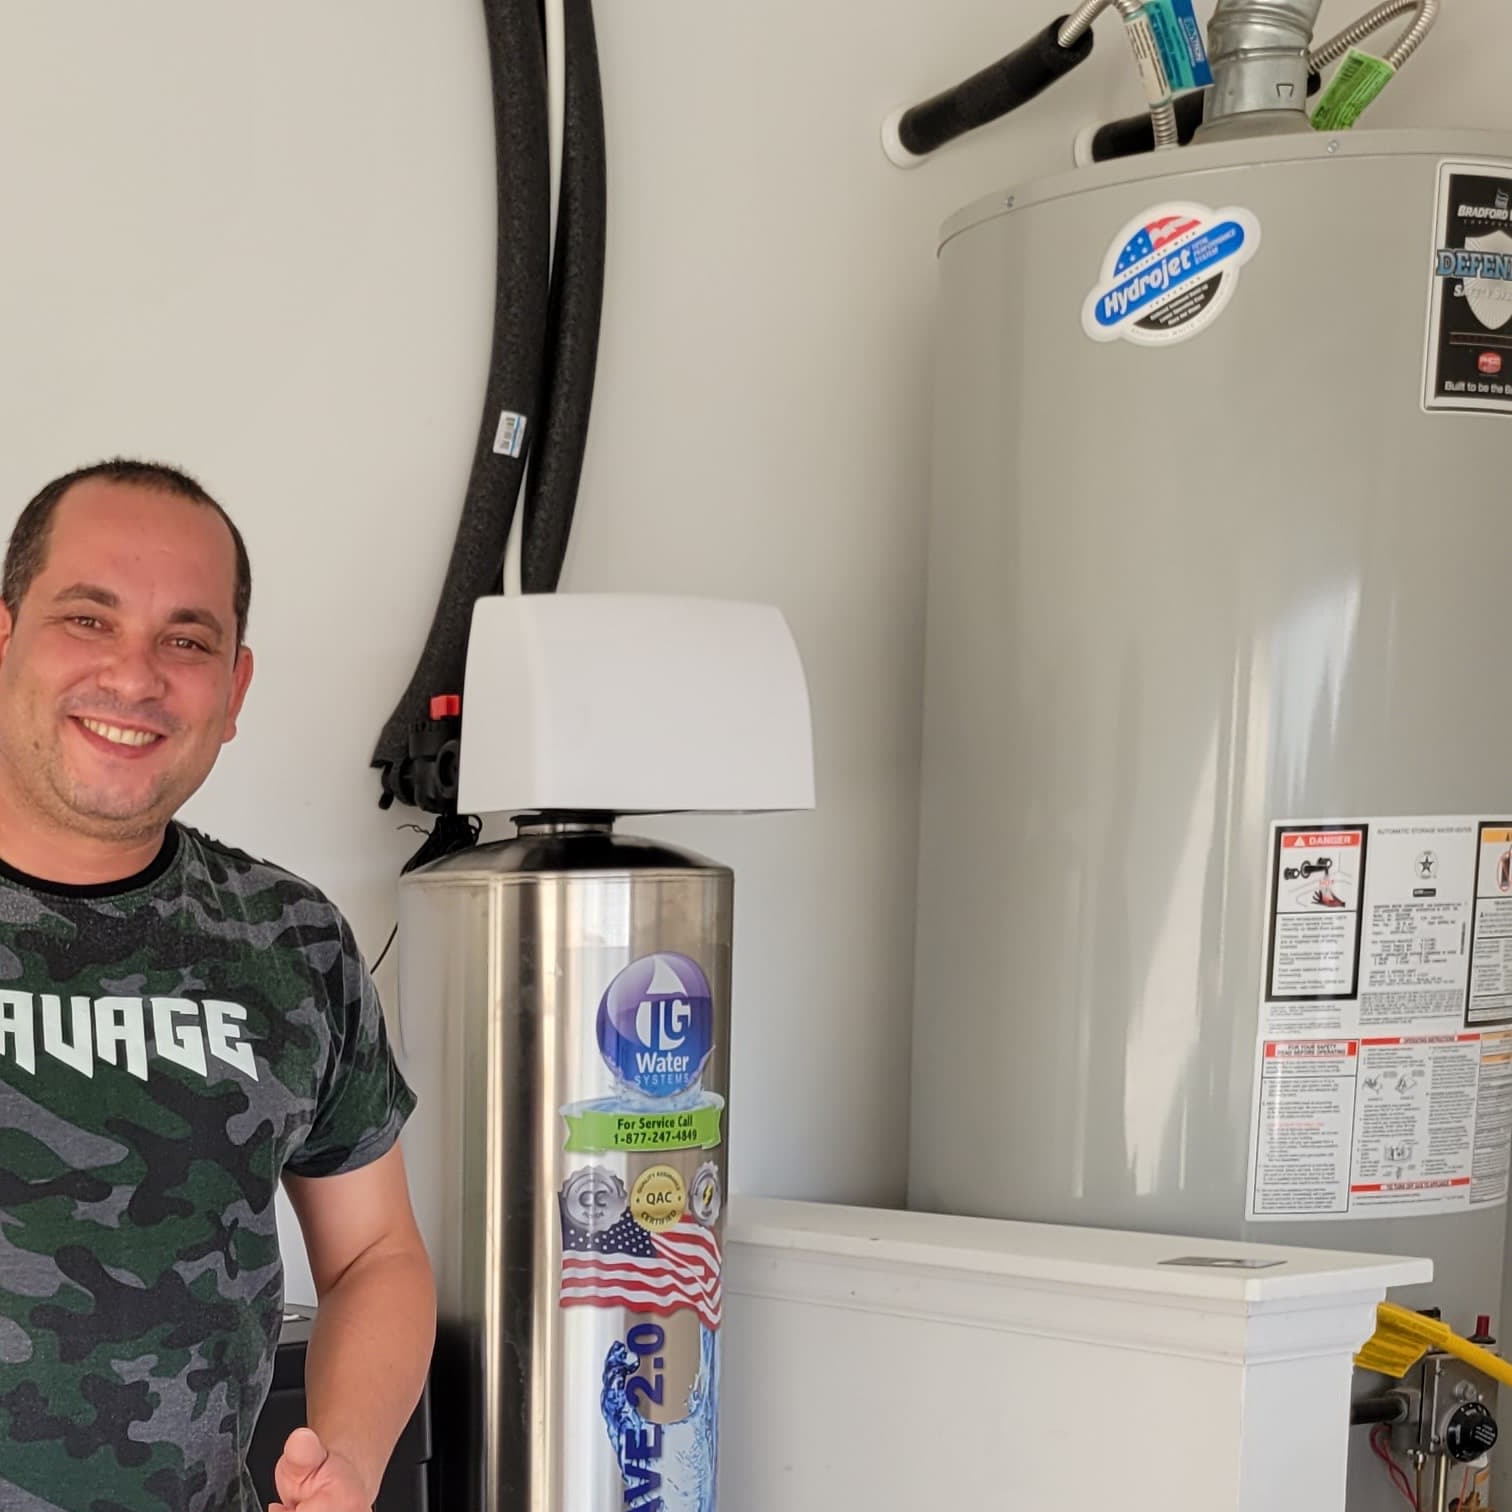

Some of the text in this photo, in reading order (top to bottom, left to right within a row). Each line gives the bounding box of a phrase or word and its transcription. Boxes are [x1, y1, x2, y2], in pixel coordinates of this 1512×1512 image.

[1458, 205, 1508, 220] BRADFORD
[1104, 250, 1191, 318] Hydrojet
[1445, 381, 1503, 393] Built to be the
[1309, 836, 1351, 846] DANGER
[636, 1051, 689, 1074] Water
[634, 1073, 690, 1086] SYSTEMS
[617, 1116, 693, 1131] For Service Call
[613, 1130, 697, 1145] 1-877-247-4849
[646, 1192, 672, 1205] QAC
[641, 1210, 677, 1225] CERTIFIED
[624, 1323, 665, 1406] 2.0
